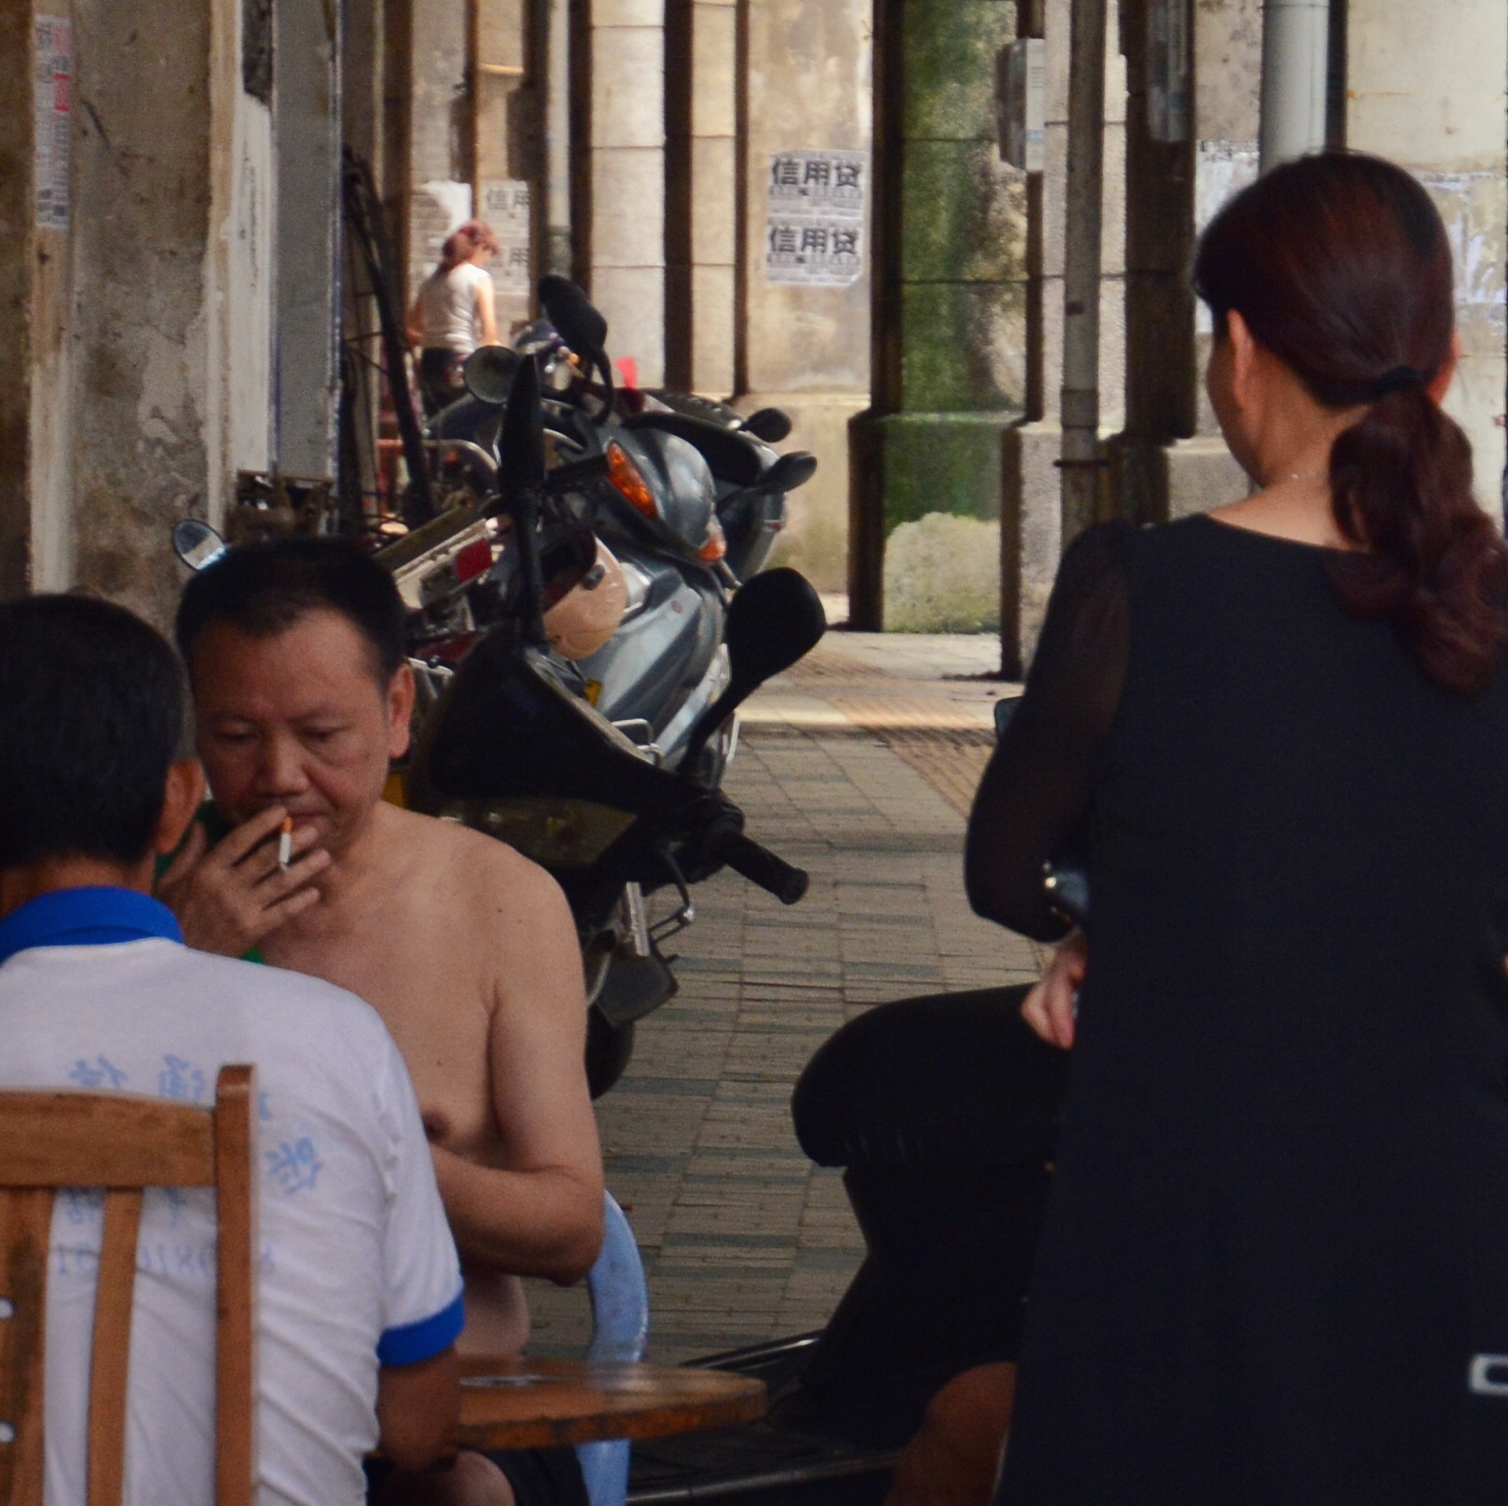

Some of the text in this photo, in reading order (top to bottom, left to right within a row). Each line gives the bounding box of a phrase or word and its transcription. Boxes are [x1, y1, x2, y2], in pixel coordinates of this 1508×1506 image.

[771, 158, 862, 187] 信用贷
[768, 225, 859, 255] 信用贷
